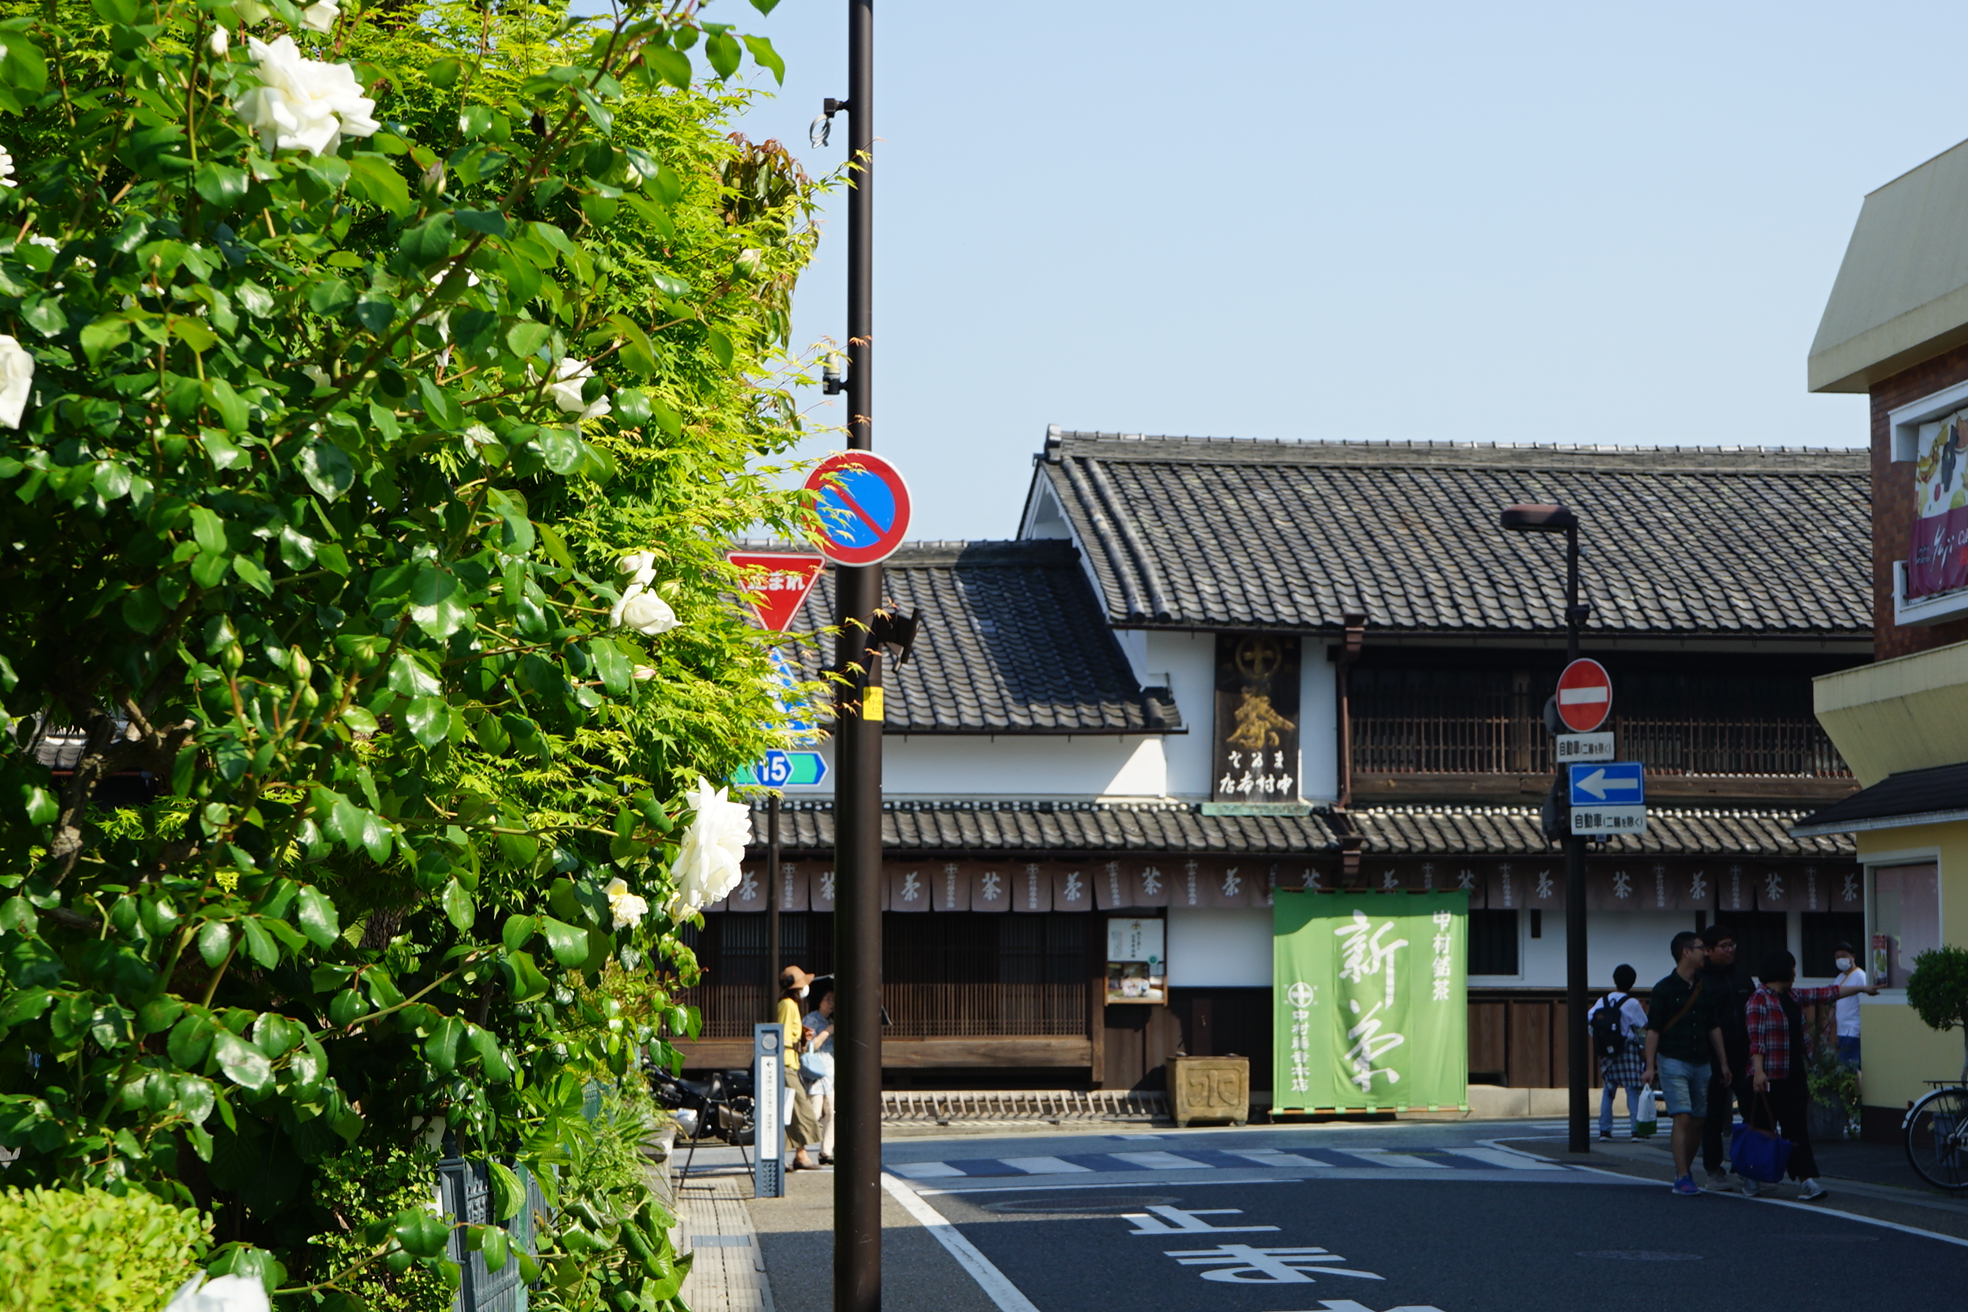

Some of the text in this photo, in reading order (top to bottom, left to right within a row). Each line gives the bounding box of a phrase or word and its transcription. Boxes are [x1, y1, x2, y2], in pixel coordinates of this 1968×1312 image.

[759, 756, 787, 782] 15
[1334, 909, 1409, 1093] 新茶
[1432, 910, 1451, 1001] 中村銘茶
[1121, 1205, 1446, 1312] 止ま
